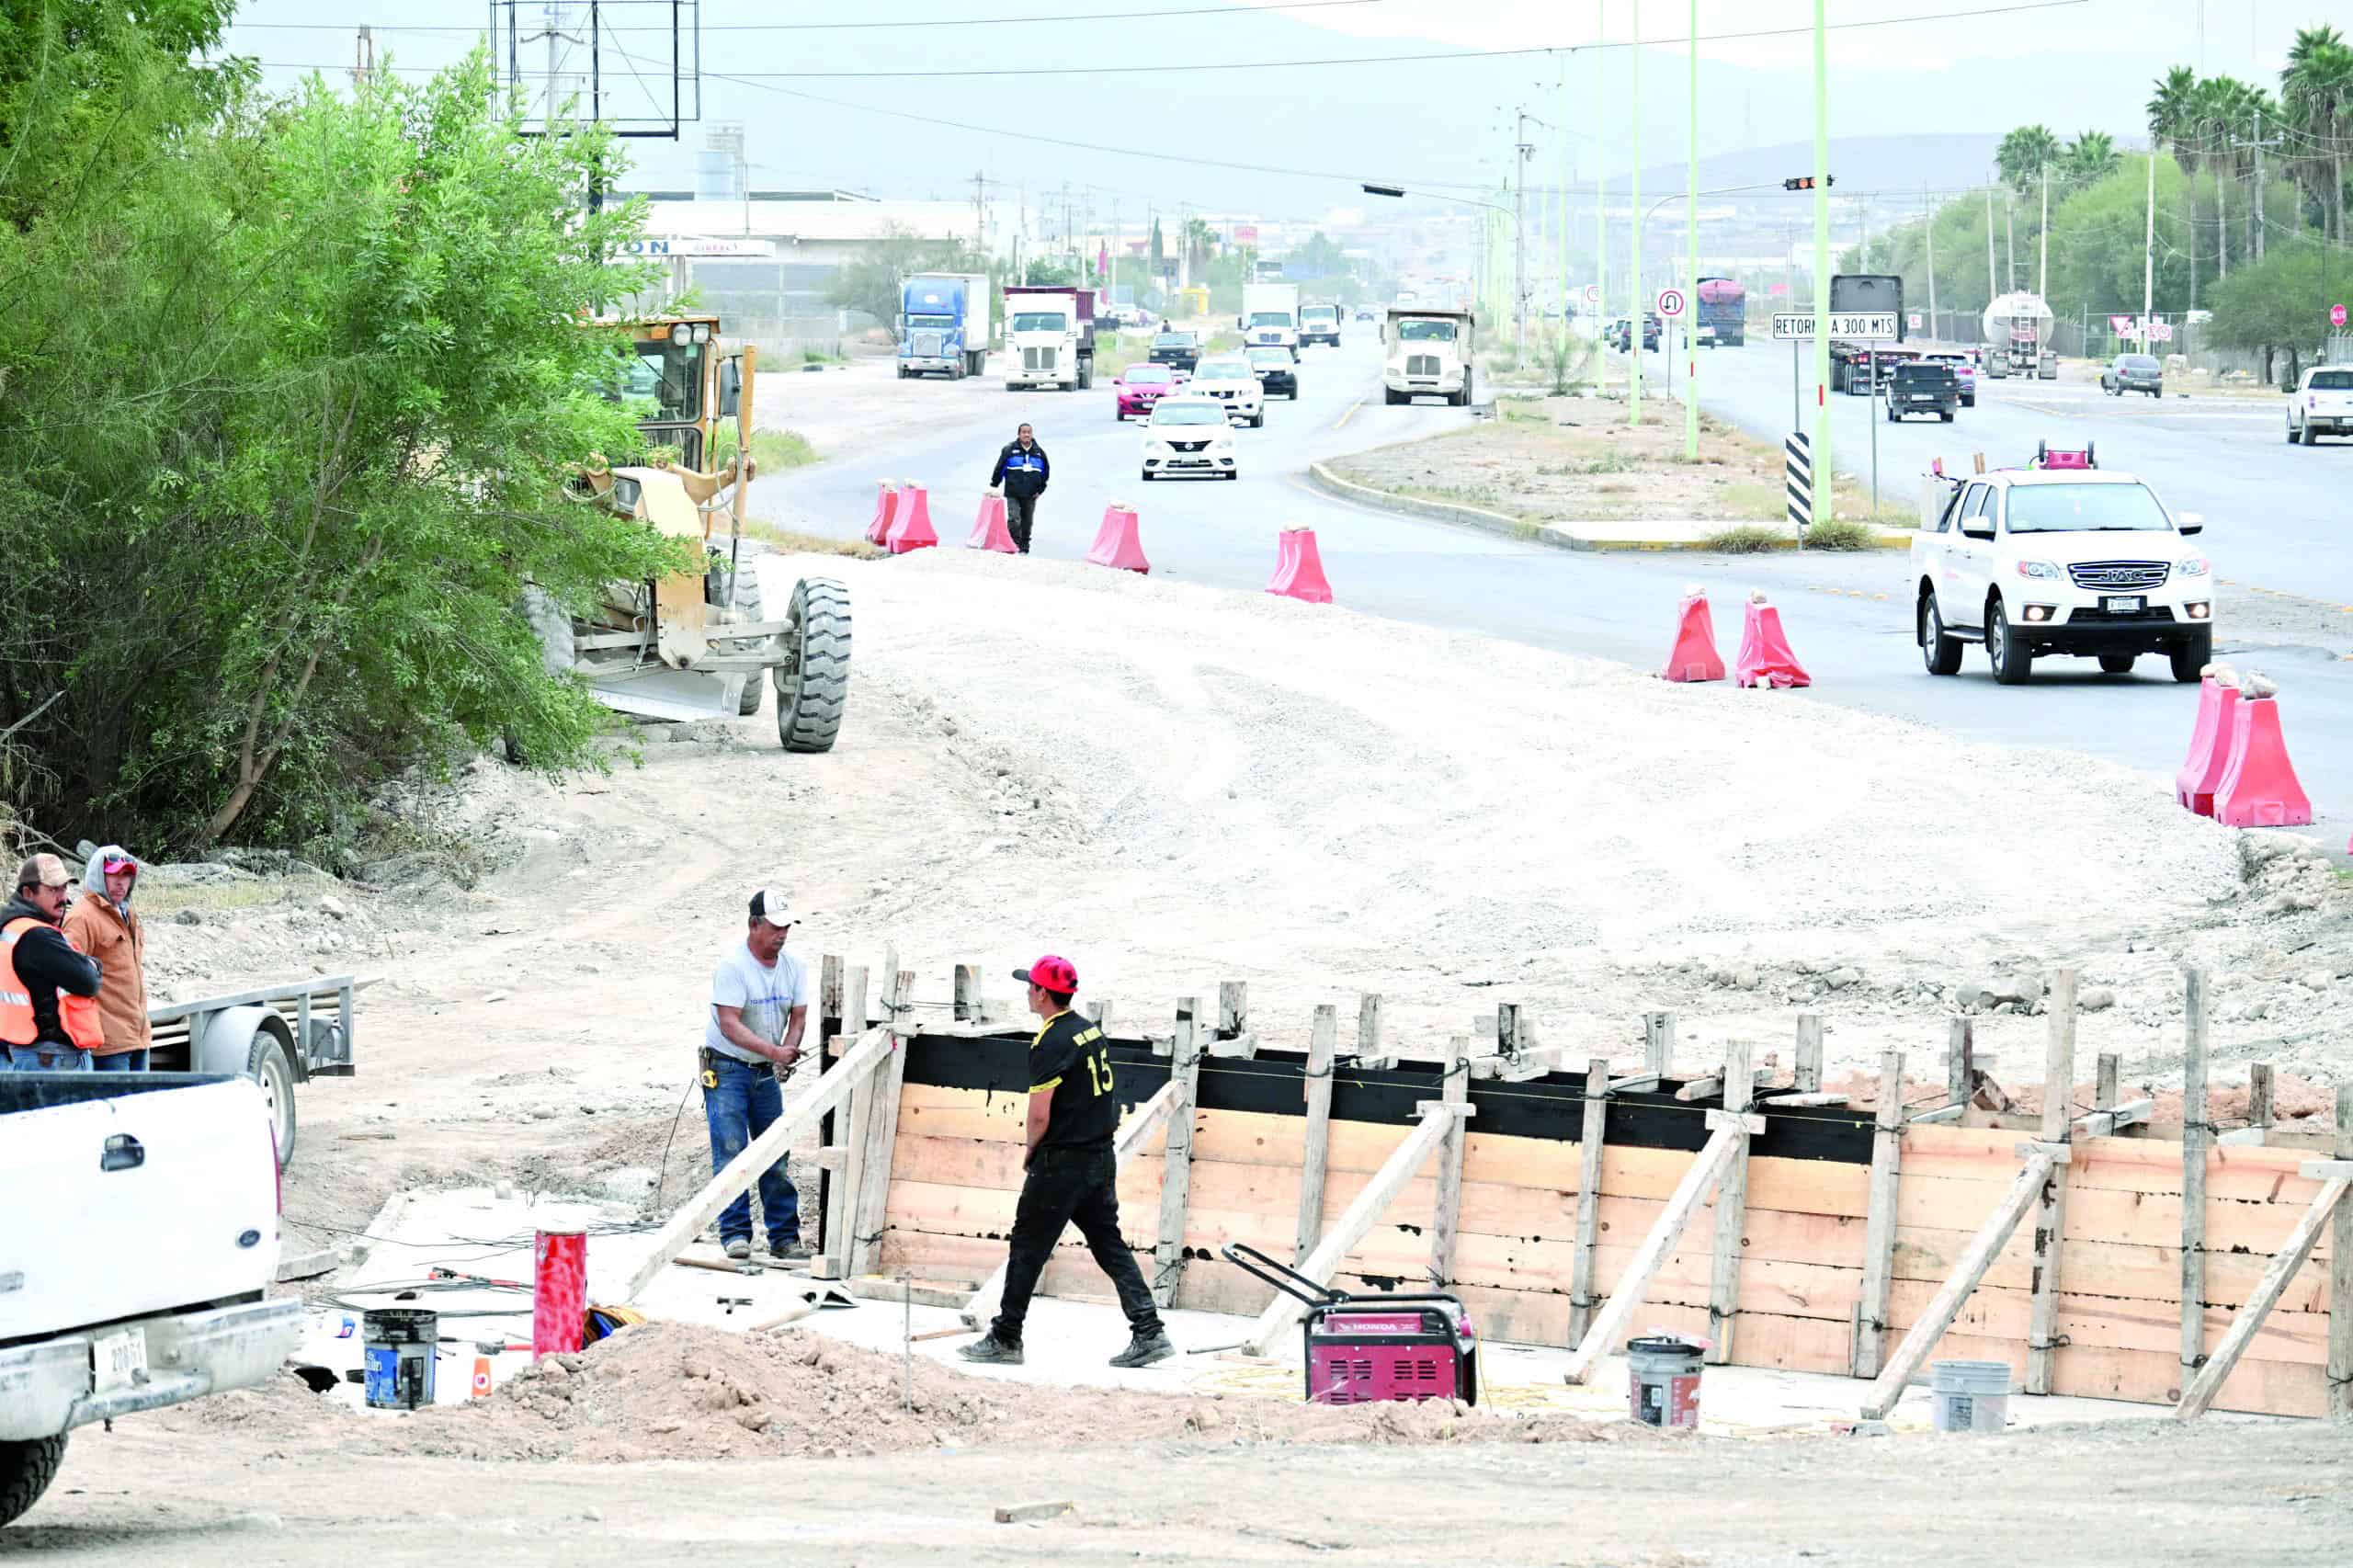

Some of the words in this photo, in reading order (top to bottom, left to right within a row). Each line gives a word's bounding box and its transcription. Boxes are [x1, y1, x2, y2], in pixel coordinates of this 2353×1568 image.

[1831, 319, 1839, 334] A
[1844, 318, 1866, 334] 300
[1871, 318, 1893, 334] MTS
[2099, 570, 2145, 582] JAC
[1087, 1047, 1113, 1096] 15
[1352, 1323, 1397, 1331] HONDA
